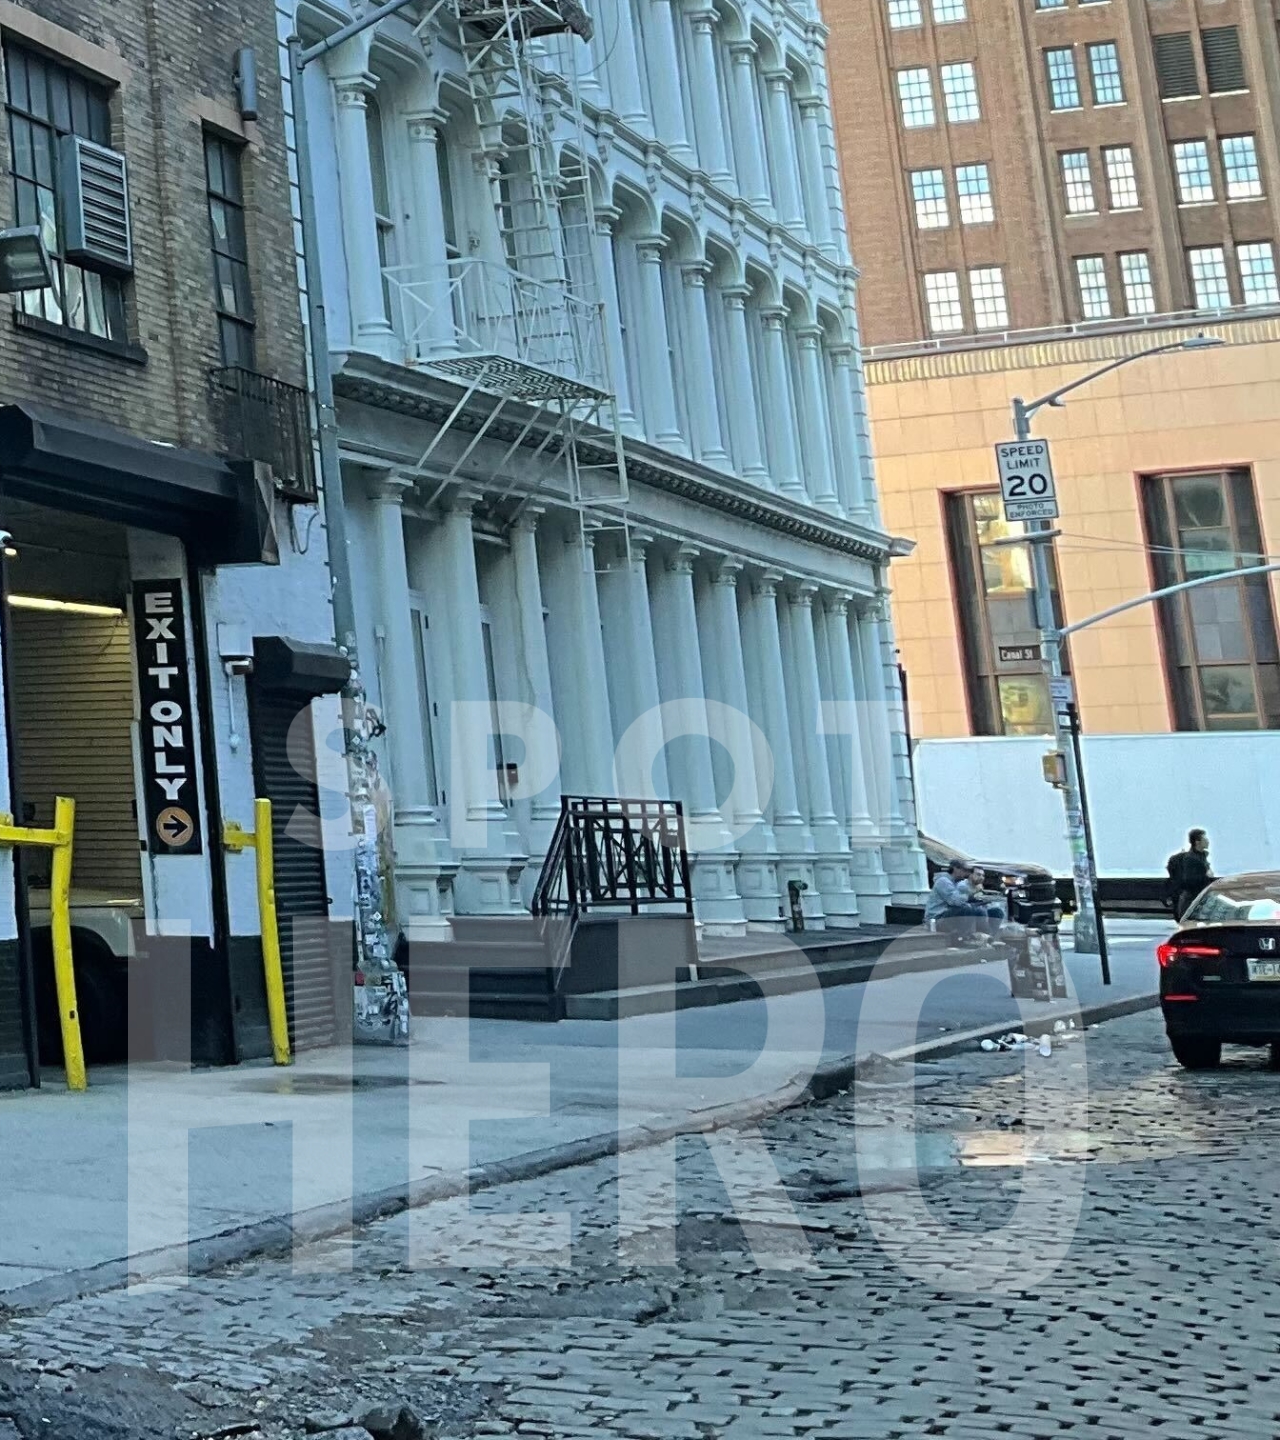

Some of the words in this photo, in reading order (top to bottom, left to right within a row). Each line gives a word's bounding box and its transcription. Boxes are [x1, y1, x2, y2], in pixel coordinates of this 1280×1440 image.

[1001, 445, 1043, 458] SPEED
[1007, 458, 1040, 470] LIMIT
[1007, 473, 1047, 496] 20
[1017, 502, 1044, 510] PHOTO
[1010, 509, 1053, 518] ENFORCED
[145, 592, 178, 689] EXIT
[1001, 649, 1022, 660] Canal
[1025, 648, 1033, 659] St
[150, 700, 187, 800] ONLY
